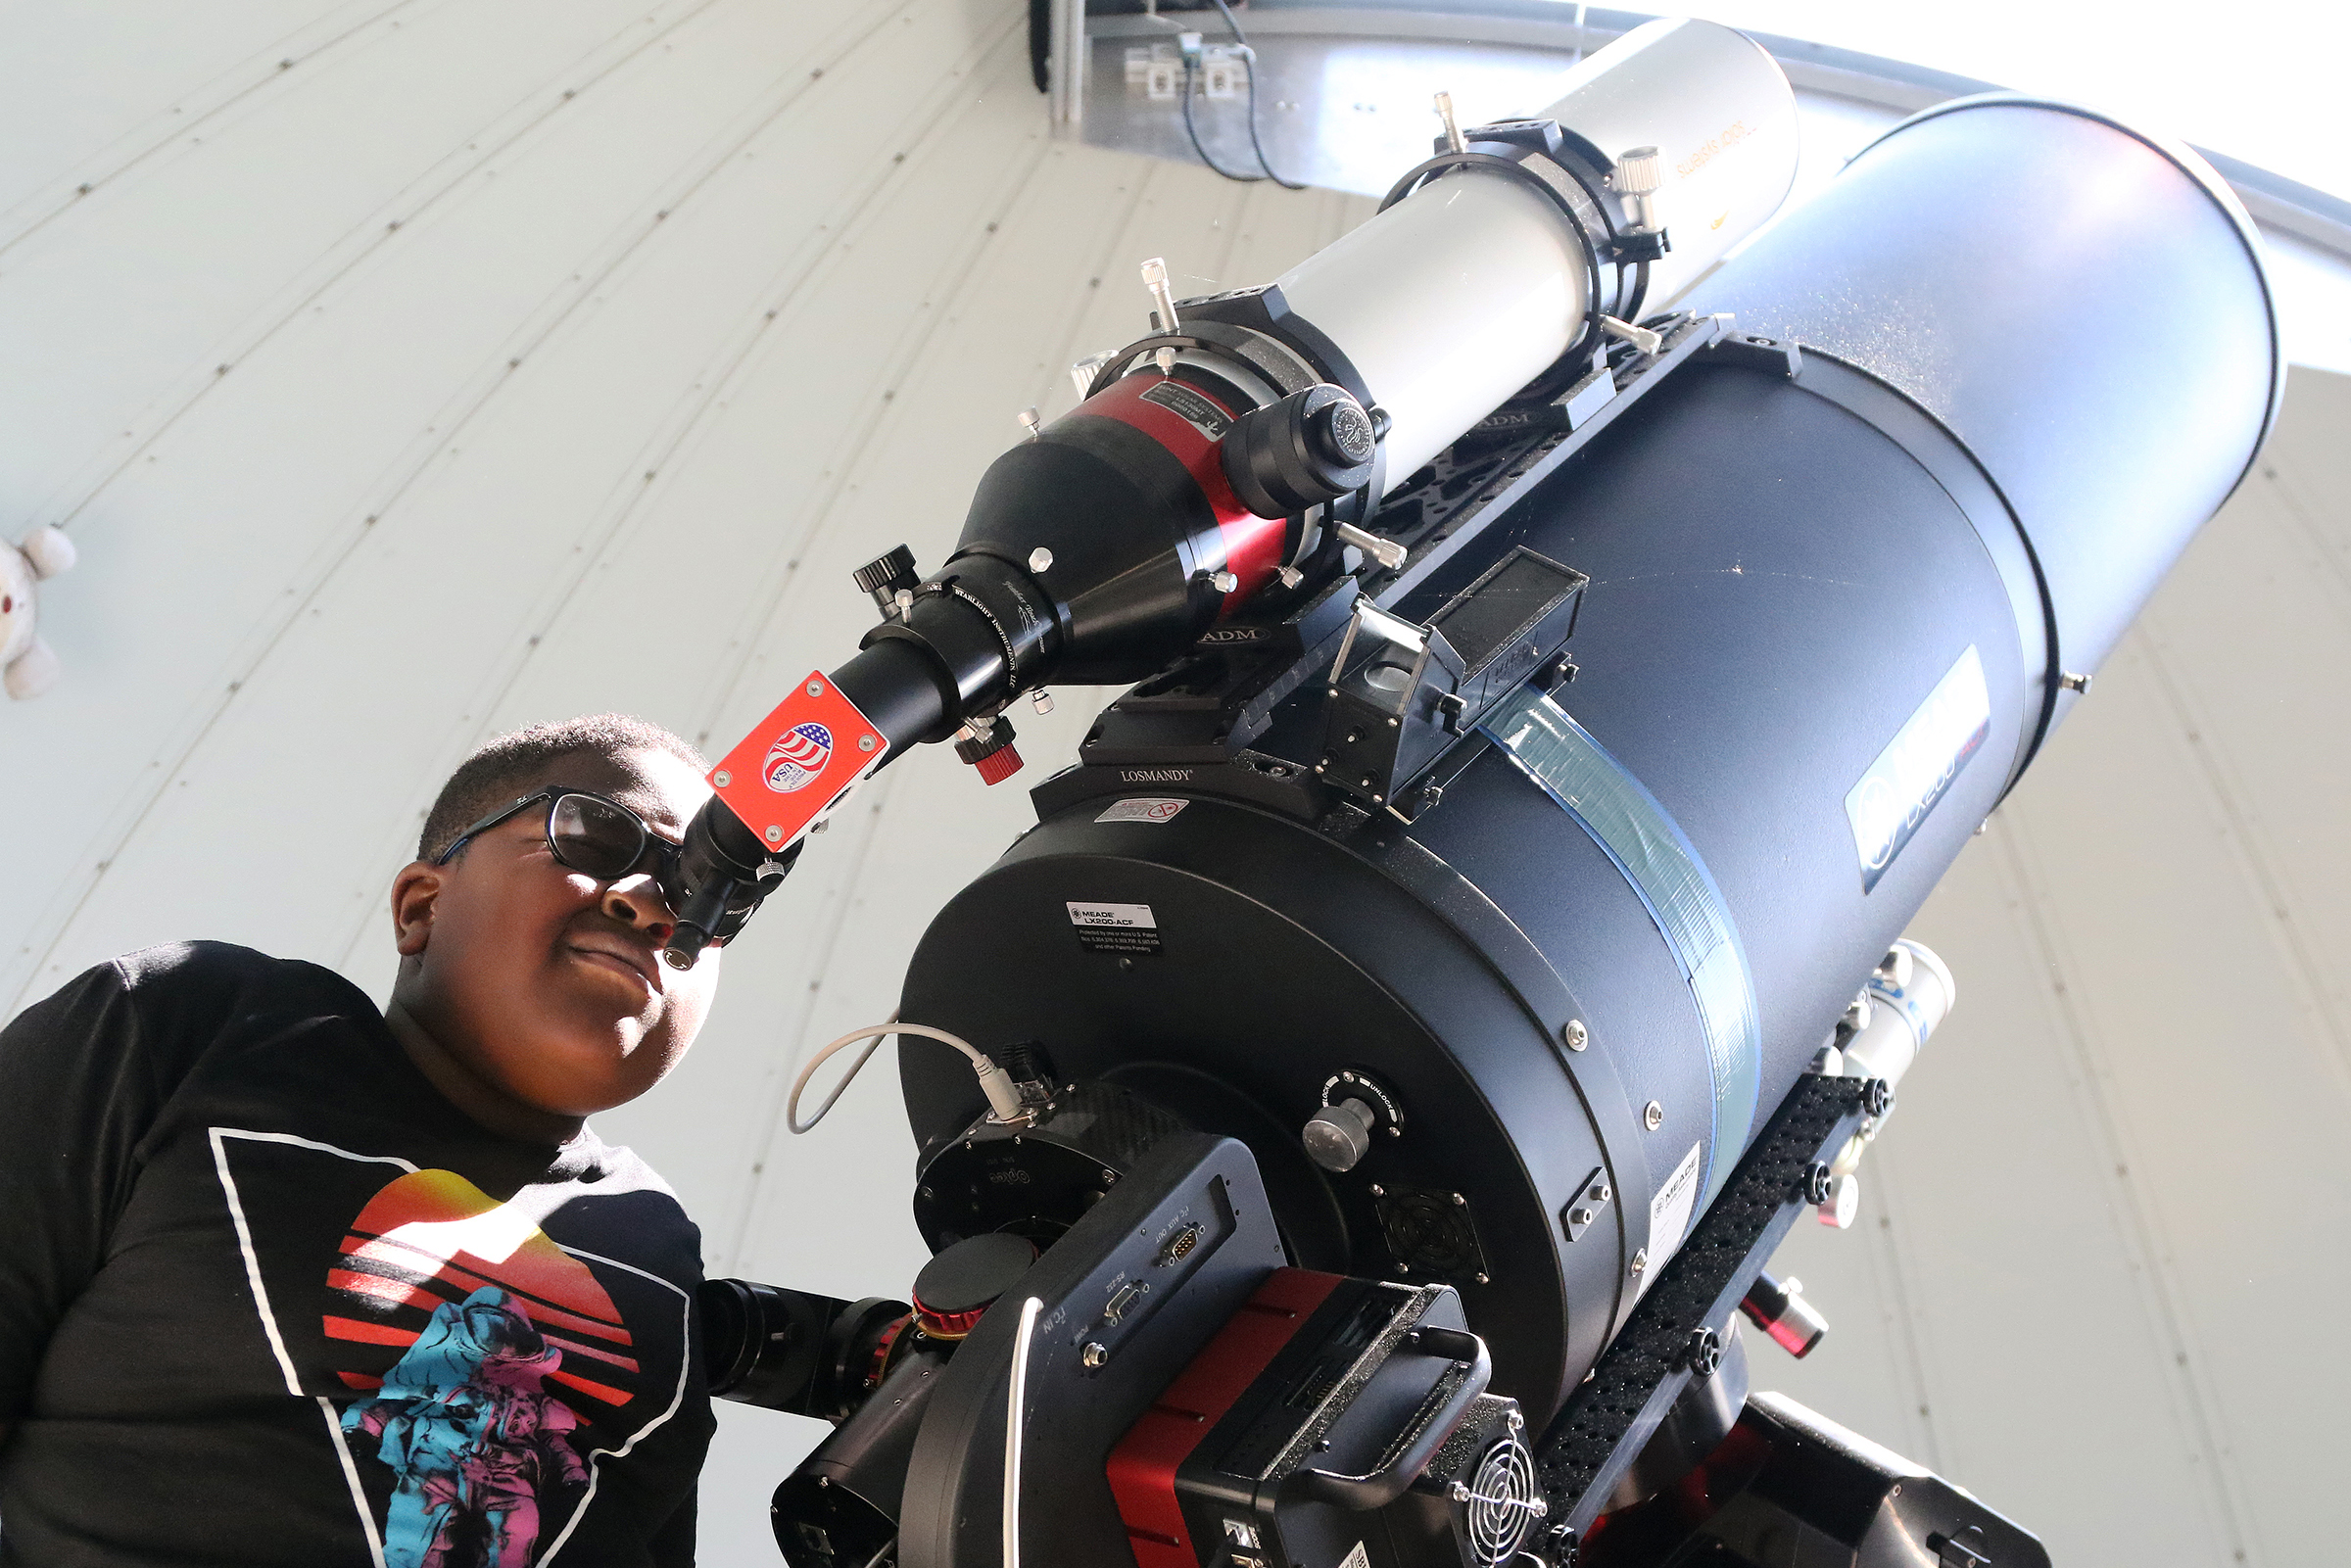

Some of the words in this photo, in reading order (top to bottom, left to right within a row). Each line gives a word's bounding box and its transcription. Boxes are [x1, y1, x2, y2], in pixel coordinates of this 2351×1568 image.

[1477, 413, 1529, 428] ADM
[954, 588, 993, 619] STARLIGHT
[991, 617, 1017, 672] INSTRUMENTS
[1200, 629, 1260, 641] ADM
[772, 763, 793, 783] USA
[1321, 1084, 1331, 1102] LOCK
[1369, 1083, 1393, 1110] UNLOCK
[1665, 1155, 1698, 1203] MEADE
[1155, 1229, 1169, 1244] OUT
[1043, 1319, 1055, 1334] IN
